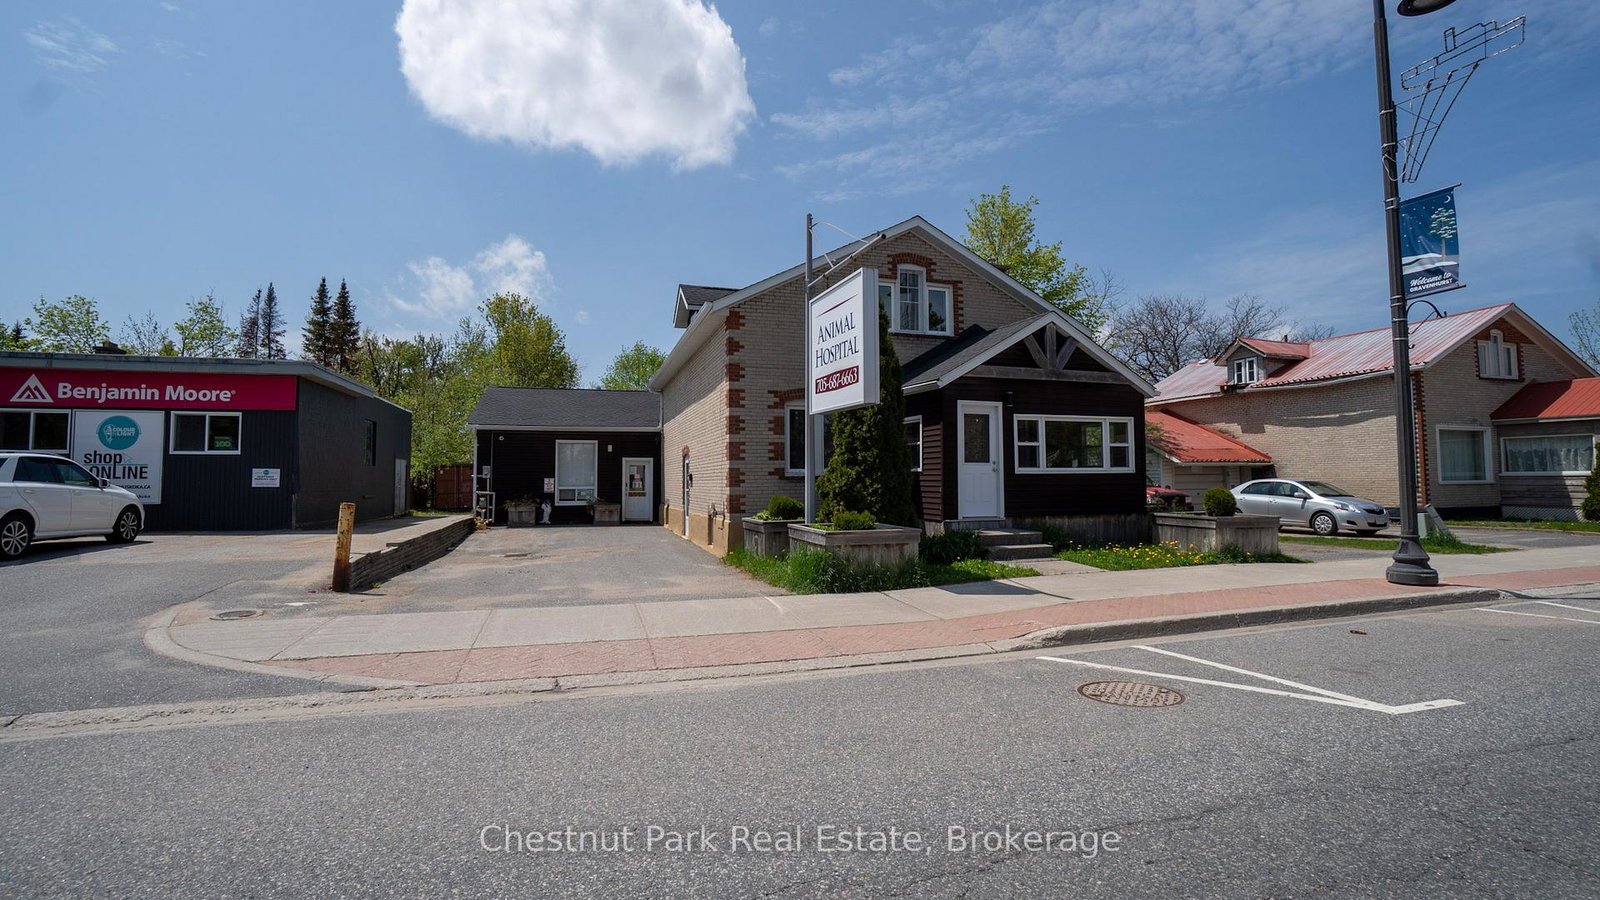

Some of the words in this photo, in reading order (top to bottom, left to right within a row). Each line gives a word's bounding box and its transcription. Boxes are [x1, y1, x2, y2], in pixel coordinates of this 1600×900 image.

[1410, 275, 1442, 286] Welcome
[1410, 278, 1452, 292] GRAVENHURST
[817, 312, 856, 344] ANIMAL
[815, 336, 859, 368] HOSPITAL
[816, 369, 857, 392] 705-687-6663
[57, 382, 159, 403] Benjamin
[83, 450, 122, 467] shop
[89, 465, 148, 480] ONLINE
